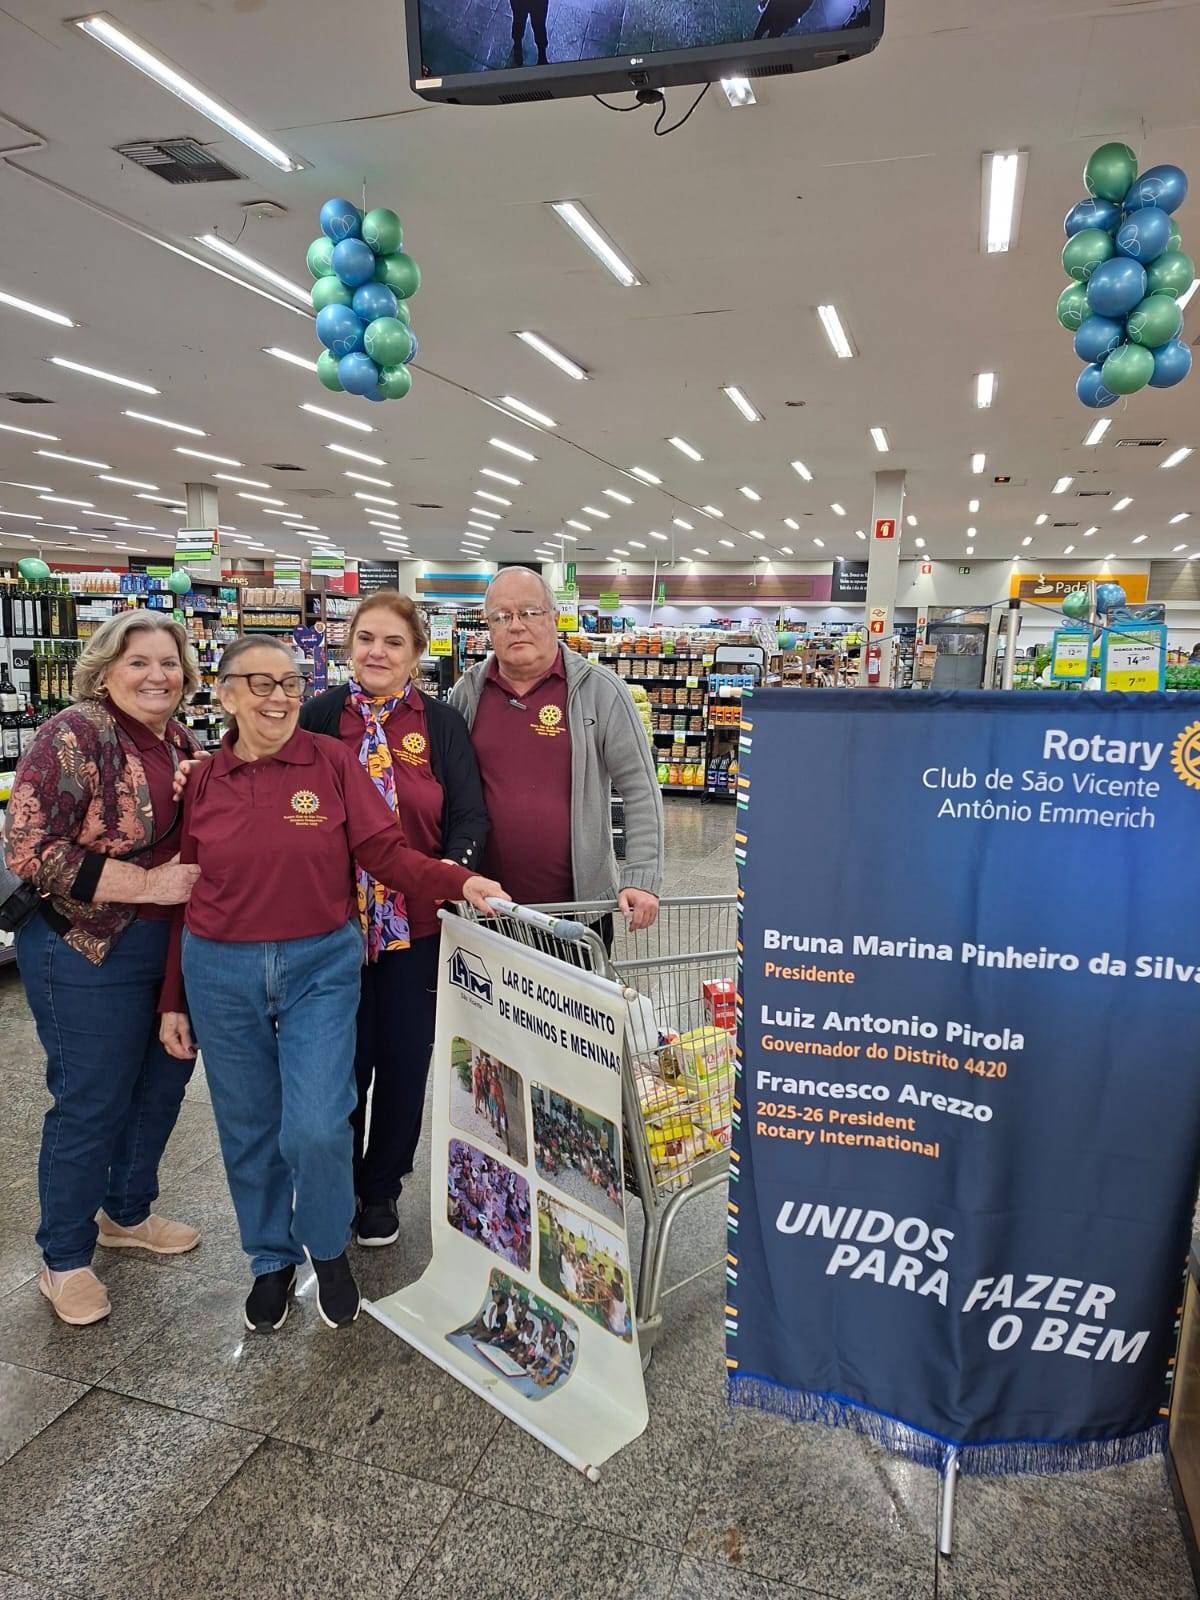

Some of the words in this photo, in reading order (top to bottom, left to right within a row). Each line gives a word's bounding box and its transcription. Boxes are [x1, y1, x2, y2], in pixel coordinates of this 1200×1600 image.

[1043, 729, 1163, 771] Rotary
[922, 767, 977, 789] Club
[985, 768, 1014, 790] de
[1021, 770, 1064, 793] São
[1072, 772, 1160, 798] Vicente
[937, 798, 1032, 823] Antônio
[1039, 802, 1155, 829] Emmerich
[763, 929, 843, 955] Bruna
[852, 935, 953, 962] Marina
[961, 942, 1080, 972] Pinheiro
[1088, 952, 1126, 977] da
[764, 962, 856, 985] Presidente
[502, 966, 519, 992] LAR
[521, 976, 534, 999] DE
[536, 983, 616, 1036] ACOLHIMENTO
[499, 998, 511, 1021] DE
[512, 1007, 558, 1045] MENINOS
[561, 1029, 568, 1049] E
[570, 1033, 621, 1076] MENINAS
[761, 1005, 815, 1030] Luiz
[822, 1011, 938, 1039] Antonio
[946, 1021, 1025, 1051] Pirola
[761, 1034, 861, 1058] Governador
[866, 1043, 888, 1060] do
[893, 1045, 959, 1071] Distrito
[964, 1057, 1008, 1079] 4420
[756, 1070, 890, 1101] Francesco
[897, 1084, 993, 1123] Arezzo
[756, 1101, 824, 1123] 2025-26
[829, 1109, 916, 1132] President
[756, 1121, 815, 1146] Rotary
[820, 1128, 940, 1159] International
[775, 1200, 955, 1263] UNIDOS
[825, 1244, 950, 1306] PARA
[961, 1273, 1117, 1320] FAZER
[987, 1313, 1024, 1351] O
[1030, 1317, 1151, 1364] BEM
